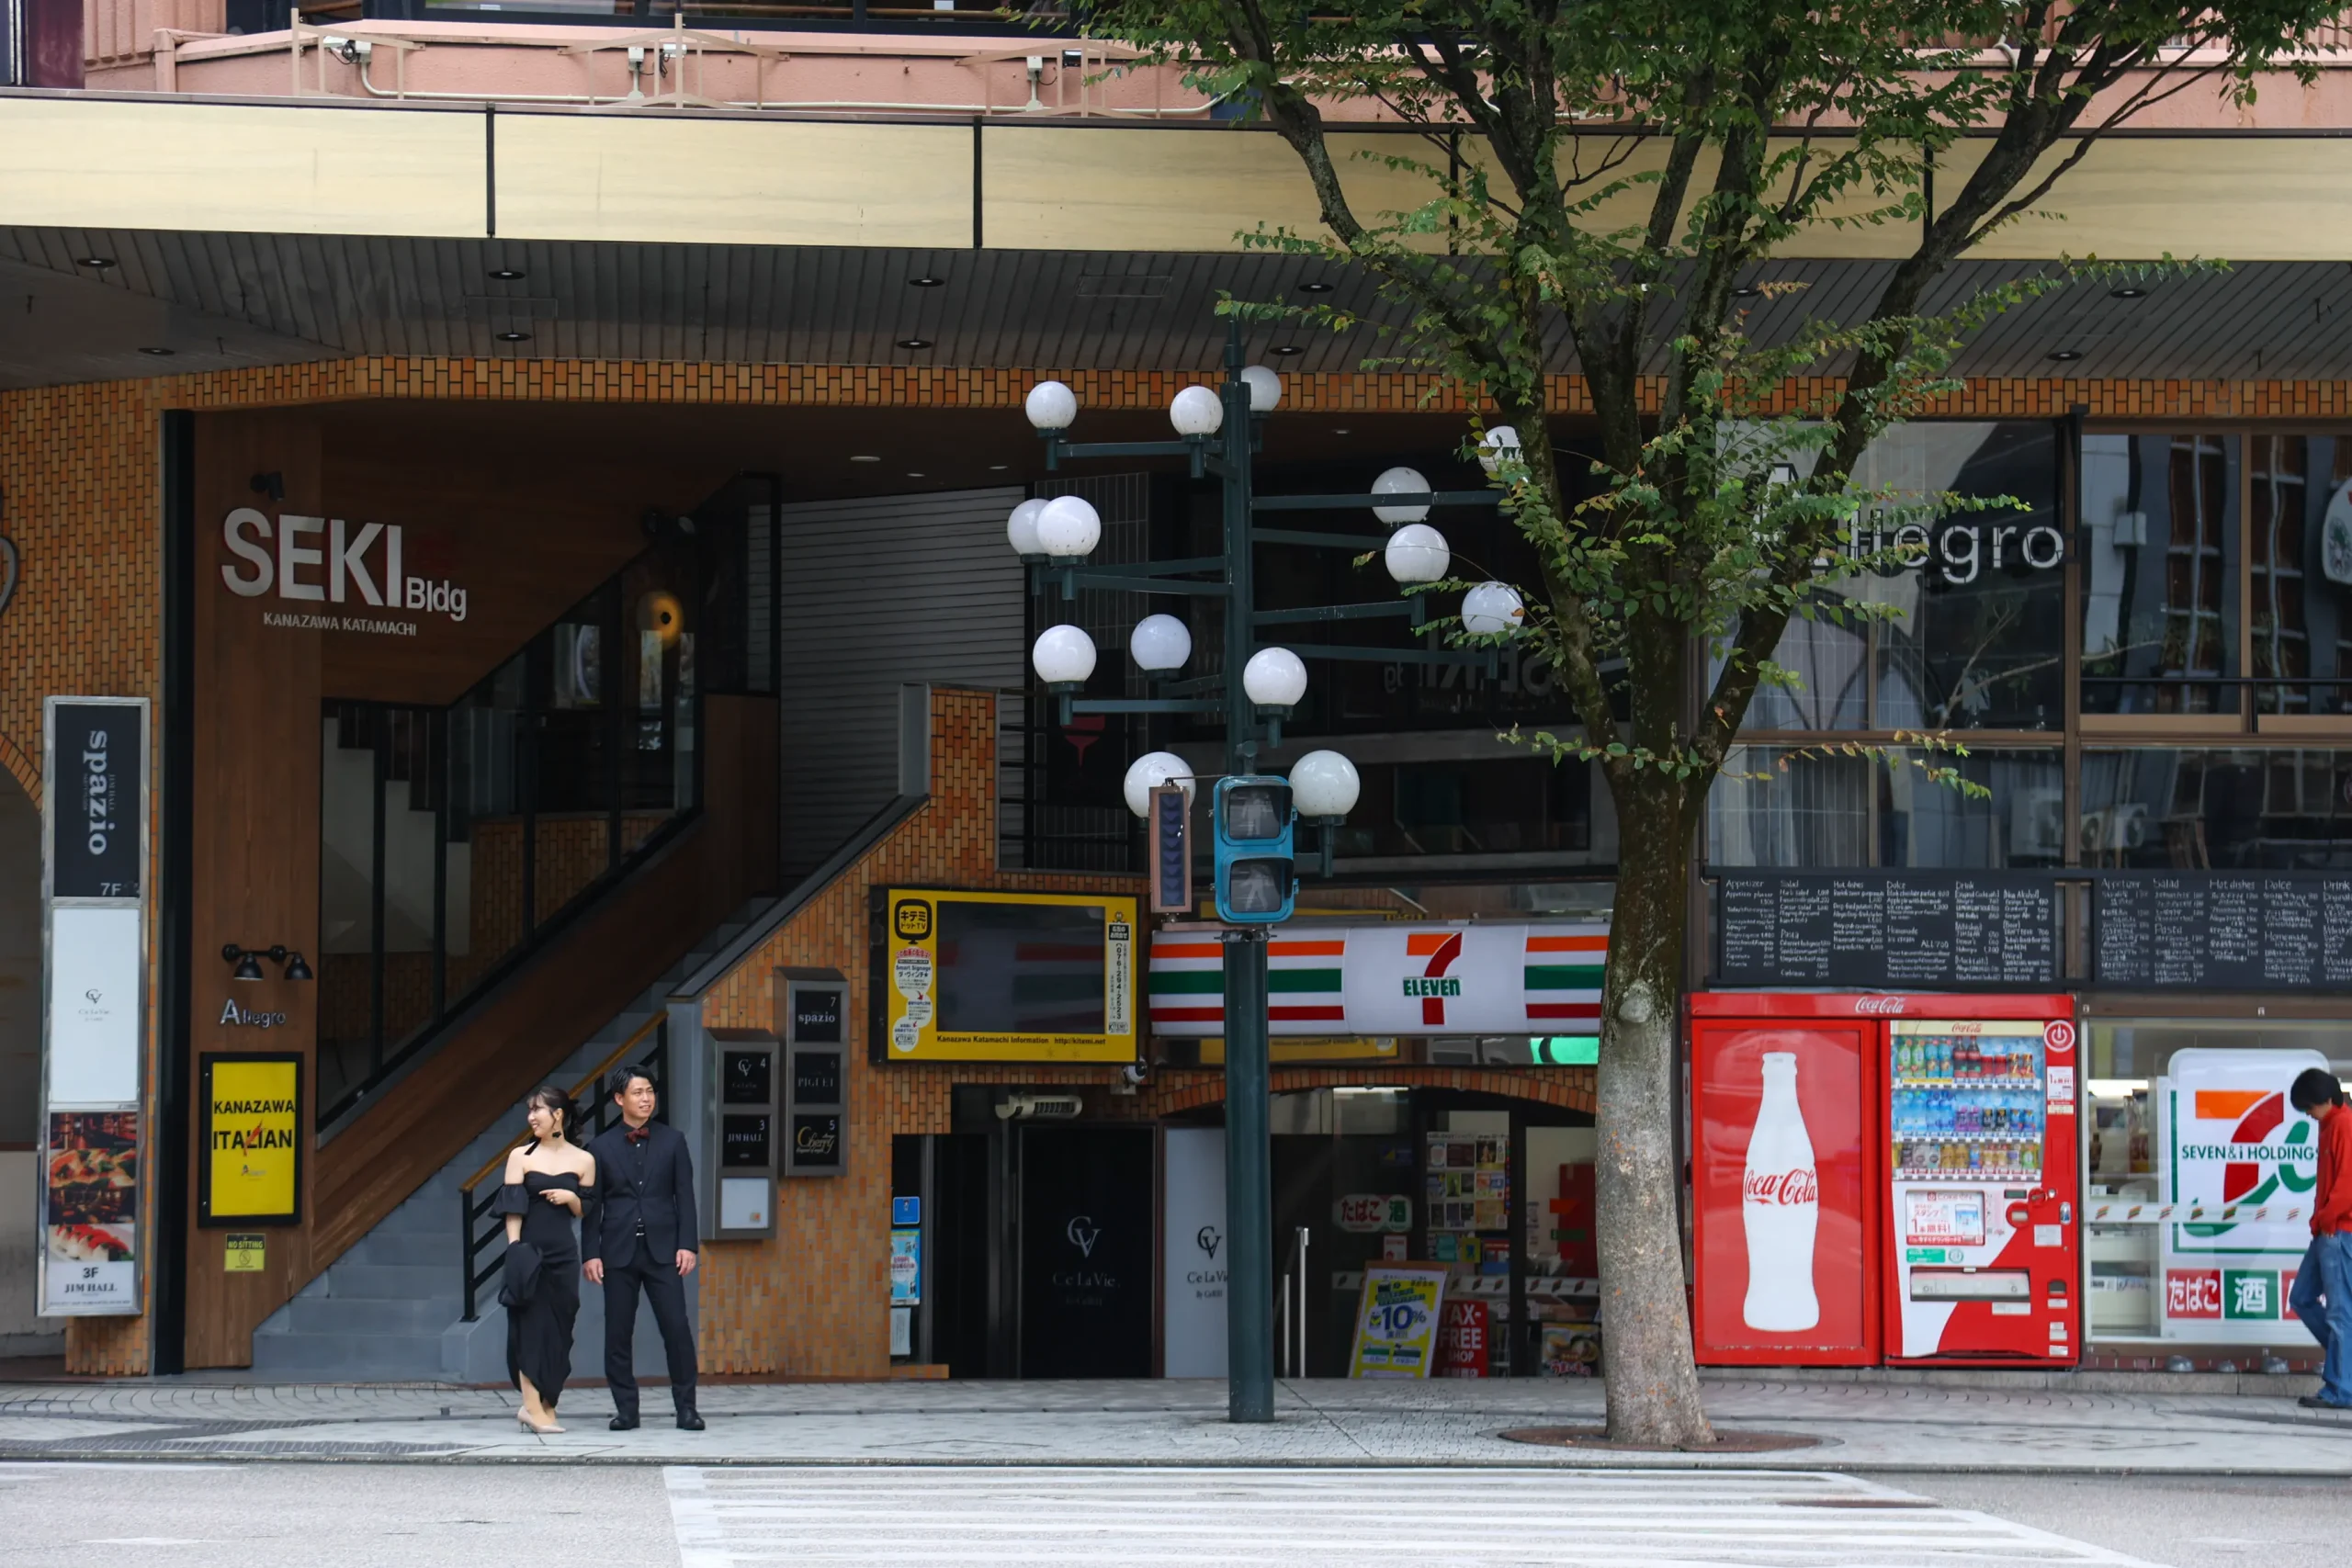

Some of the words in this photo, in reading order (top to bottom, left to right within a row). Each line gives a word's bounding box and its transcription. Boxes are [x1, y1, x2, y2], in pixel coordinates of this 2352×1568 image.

[220, 507, 403, 608] SEKI
[406, 577, 468, 622] Bldg
[263, 612, 340, 630] KANAZAWA
[342, 616, 418, 637] KATAMACHI
[84, 730, 116, 856] spazio
[100, 883, 122, 896] 7F
[1725, 879, 1765, 890] Appetizer
[1780, 879, 1799, 888] Salad
[1833, 880, 1846, 889] Hot
[1886, 880, 1906, 890] Dolce
[1955, 880, 1974, 890] Drink
[2153, 878, 2179, 889] Salad
[2209, 878, 2228, 889] Hot
[2265, 878, 2292, 890] Dolce
[2323, 880, 2350, 891] Drink
[900, 910, 927, 922] キテミ
[2154, 923, 2183, 935] Pasta
[830, 997, 836, 1007] 7
[220, 998, 287, 1029] Allegro
[797, 1010, 836, 1024] spazio
[937, 1035, 972, 1043] Kanazawa
[973, 1035, 1010, 1043] Katamachi
[759, 1058, 766, 1068] 4
[213, 1100, 295, 1114] KANAZAWA
[759, 1119, 765, 1131] 3
[829, 1120, 835, 1131] 5
[212, 1129, 294, 1150] ITALIAN
[728, 1133, 742, 1143] JIM
[2247, 1145, 2318, 1160] HOLDING
[1340, 1199, 1382, 1223] たばこ
[1388, 1200, 1406, 1223] 酒
[228, 1240, 238, 1248] NO
[239, 1240, 264, 1248] SITTING
[84, 1267, 99, 1278] 3F
[64, 1283, 85, 1293] JIM
[2168, 1276, 2219, 1312] たばこ
[2233, 1277, 2268, 1314] 酒
[1439, 1327, 1483, 1349] FREE
[1447, 1350, 1475, 1363] SHOP
